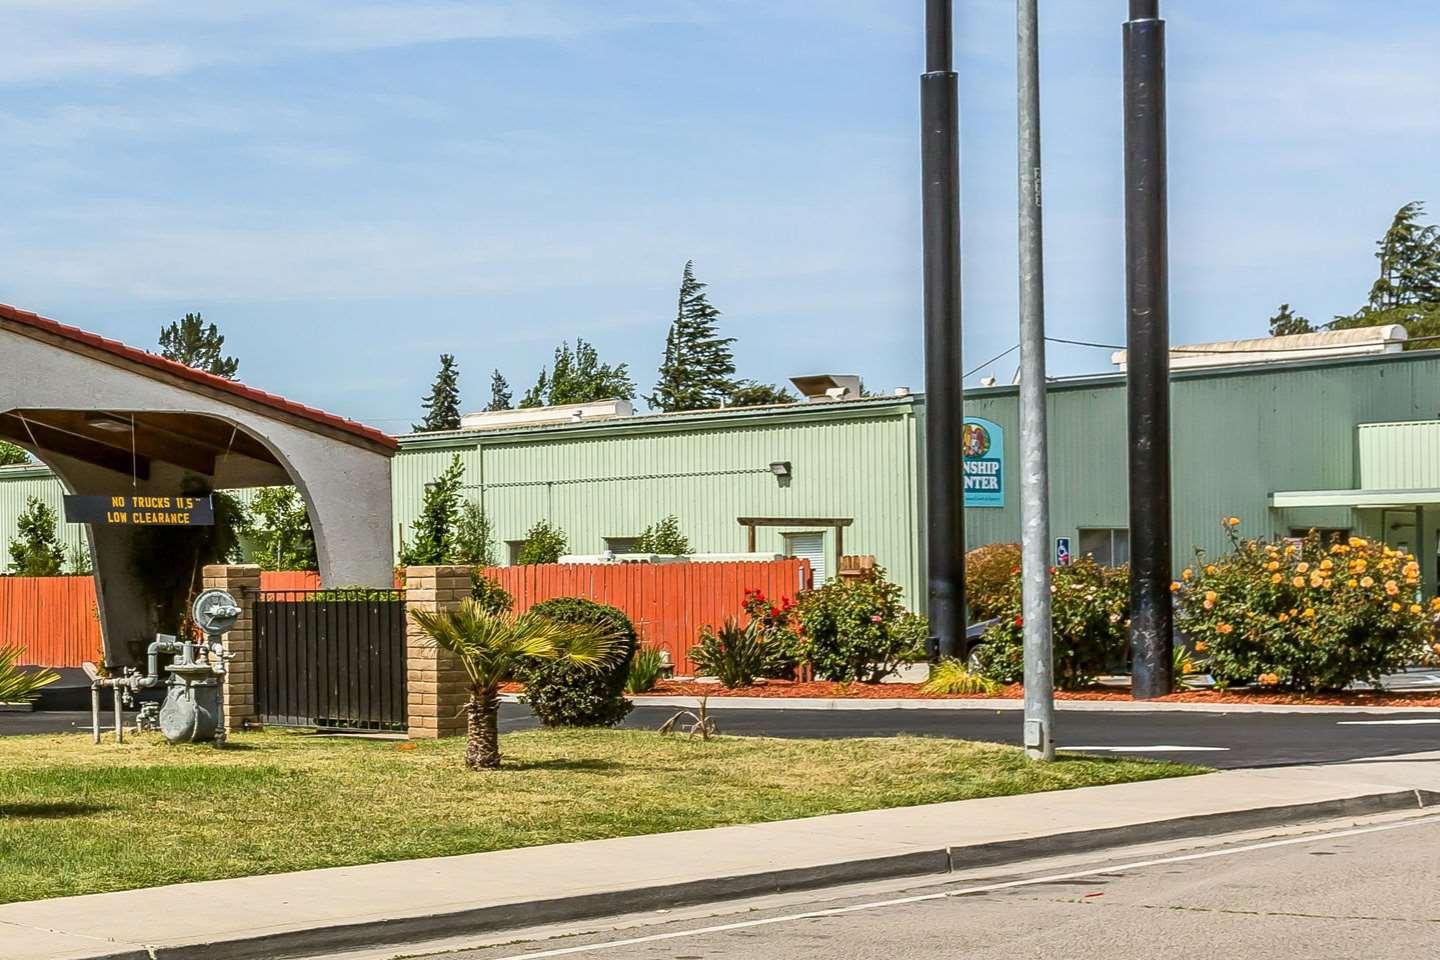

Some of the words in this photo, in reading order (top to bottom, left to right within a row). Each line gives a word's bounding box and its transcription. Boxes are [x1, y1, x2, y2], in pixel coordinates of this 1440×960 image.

[962, 461, 1000, 475] NSHIP
[963, 475, 999, 489] NTER
[111, 496, 125, 508] NO
[131, 496, 171, 509] TRUCKS
[107, 511, 127, 523] LOW
[132, 512, 190, 524] CLEARANCE
